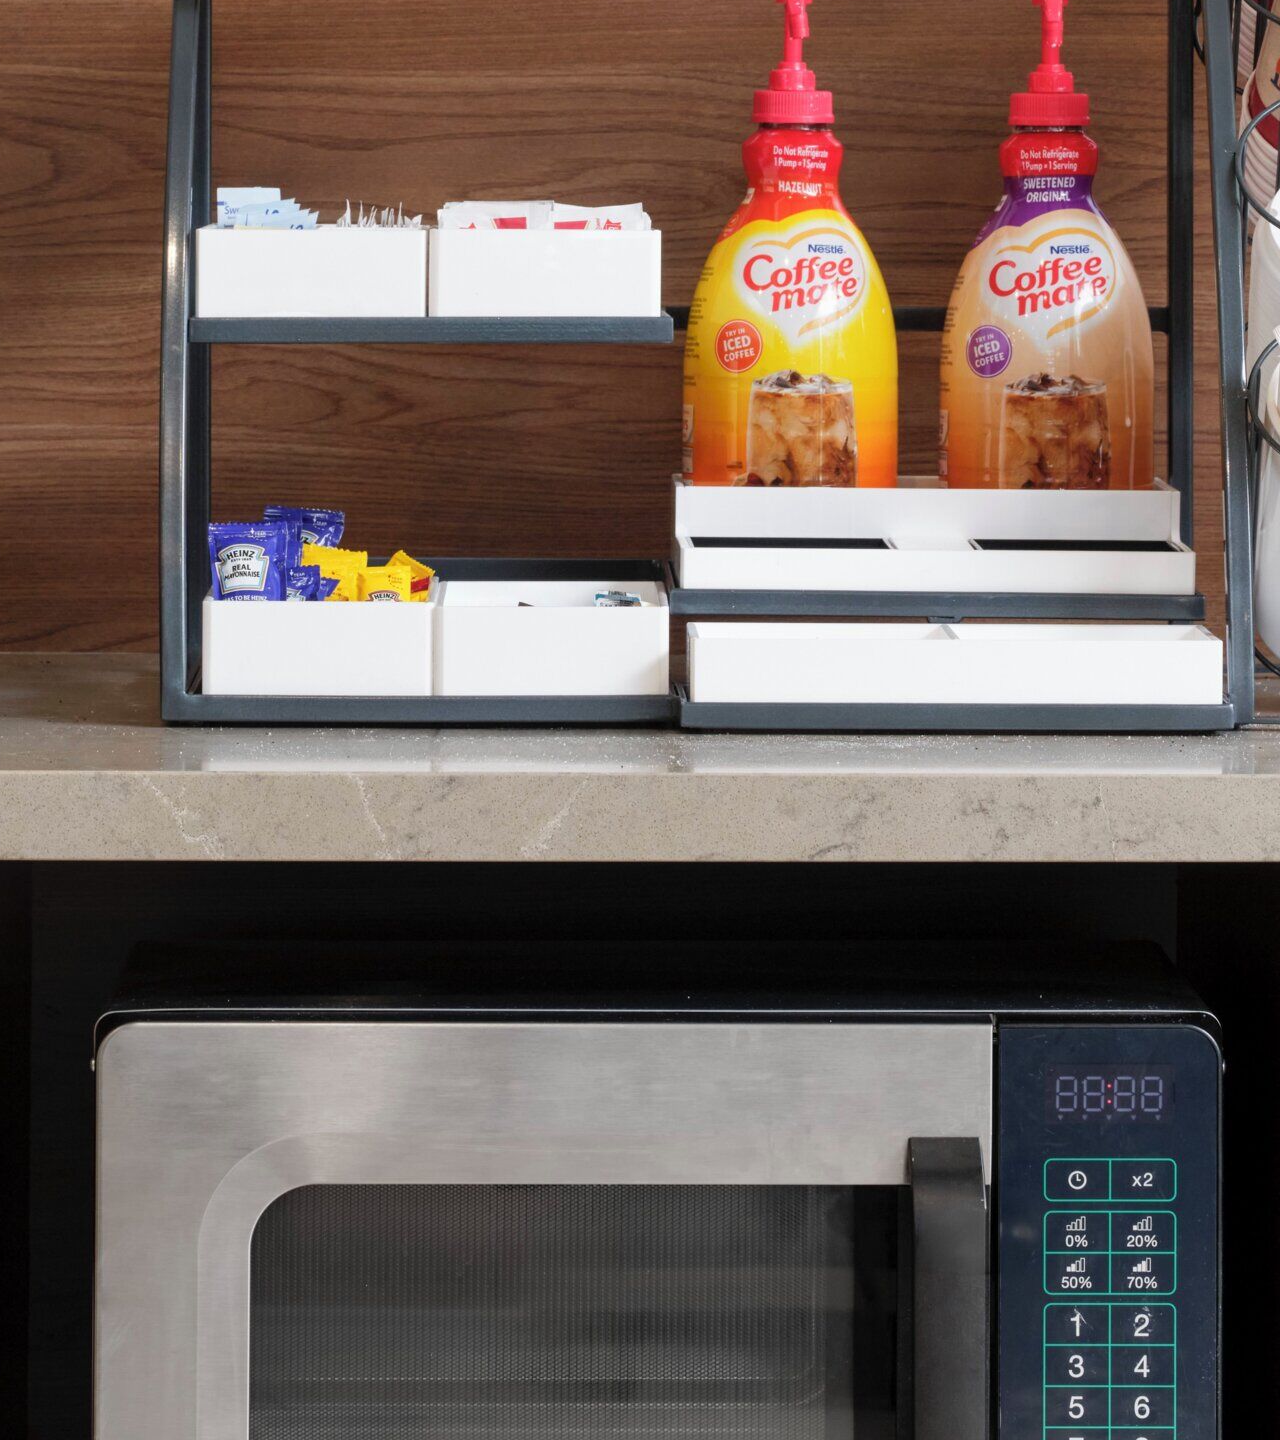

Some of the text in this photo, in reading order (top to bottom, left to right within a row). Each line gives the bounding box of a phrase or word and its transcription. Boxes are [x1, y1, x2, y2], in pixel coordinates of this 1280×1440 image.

[773, 146, 782, 155] Do
[784, 146, 796, 156] Not
[1020, 149, 1079, 160] Do Not Refrigerate
[778, 157, 798, 168] Pump
[806, 159, 826, 172] Serving
[1026, 162, 1042, 171] Pump
[1052, 161, 1078, 172] Serving
[778, 180, 822, 195] HAZELNUT
[1024, 176, 1076, 190] SWEETENED
[1026, 191, 1070, 202] ORIGINAL
[742, 254, 854, 292] Coffee
[988, 256, 1102, 297] Coffee
[771, 276, 858, 312] mate
[1016, 276, 1107, 316] mate
[726, 329, 736, 338] TRY
[723, 335, 751, 352] ICED
[974, 340, 1000, 358] ICED
[724, 348, 755, 362] COFFEE
[975, 352, 1005, 368] COFFEE
[226, 550, 255, 560] HEINZ
[224, 570, 260, 580] MAYONNAISE
[232, 564, 251, 572] REAL
[1132, 1172, 1153, 1188] x2
[1065, 1234, 1088, 1248] 0%
[1126, 1234, 1158, 1248] 20%
[1060, 1276, 1092, 1290] 50%
[1126, 1276, 1158, 1290] 70%
[1070, 1314, 1081, 1337] 1
[1134, 1314, 1150, 1337] 2
[1068, 1354, 1085, 1378] 3
[1133, 1354, 1150, 1378] 4
[1068, 1396, 1085, 1420] 5
[1133, 1396, 1150, 1420] 6
